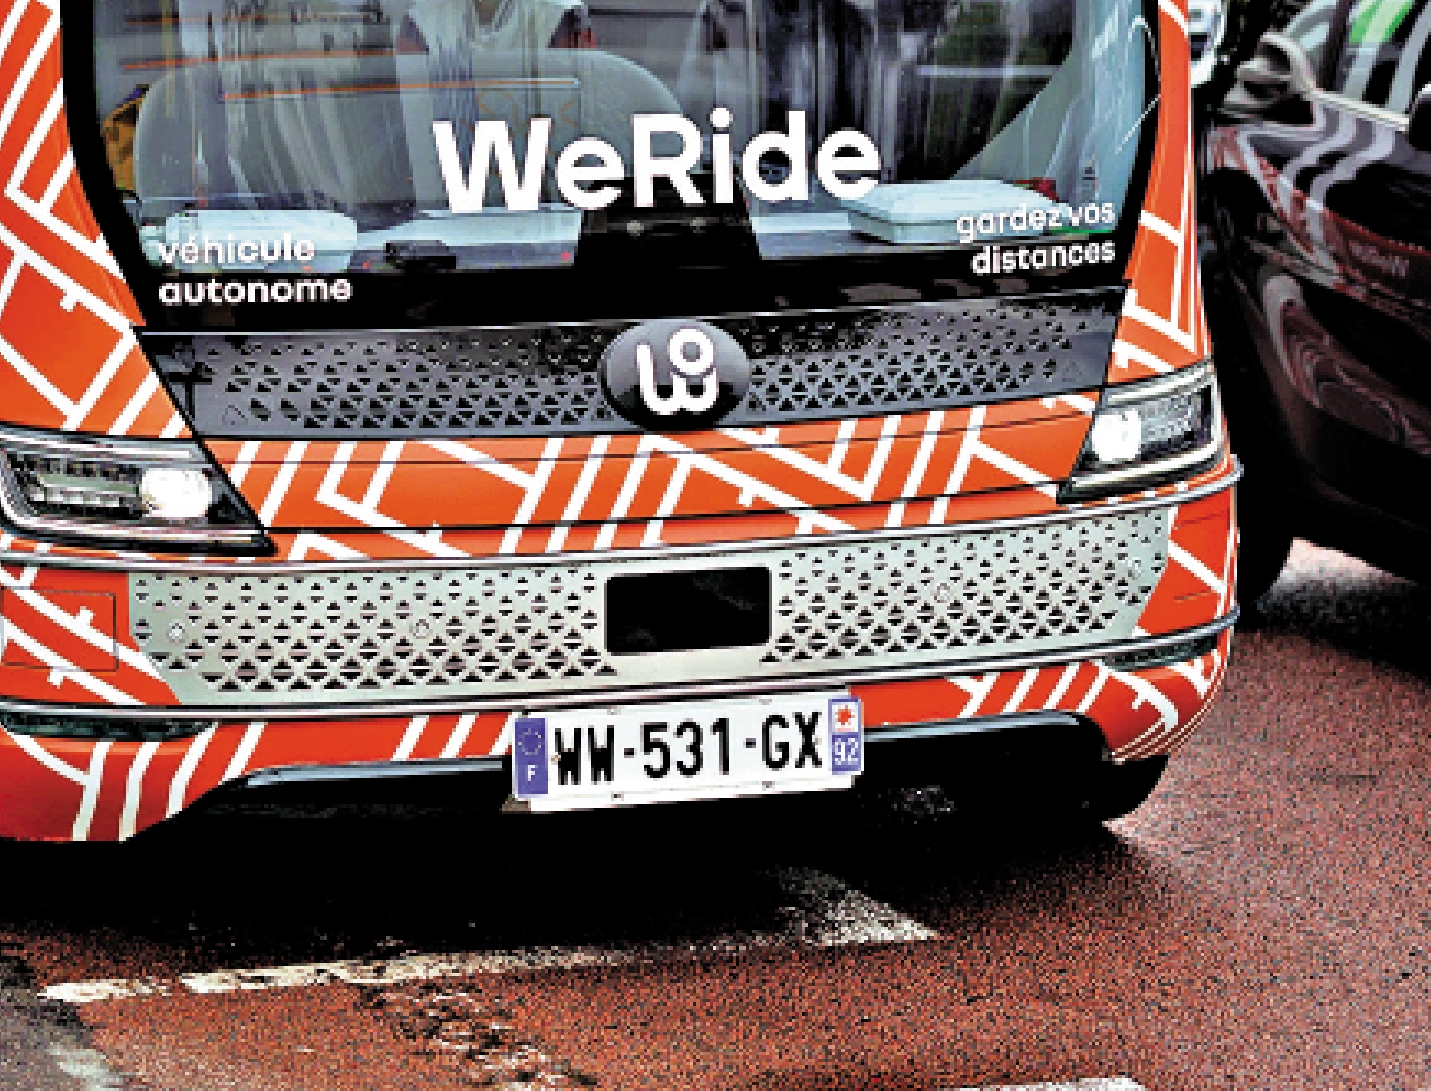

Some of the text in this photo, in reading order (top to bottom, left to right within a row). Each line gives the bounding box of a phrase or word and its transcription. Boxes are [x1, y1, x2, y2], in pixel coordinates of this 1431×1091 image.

[432, 107, 882, 214] WeRide
[956, 202, 1117, 244] gardez vos
[158, 232, 315, 265] véhicule
[970, 240, 1117, 277] distances
[158, 277, 354, 307] autonome
[526, 711, 860, 786] F WW-531-GX 92
